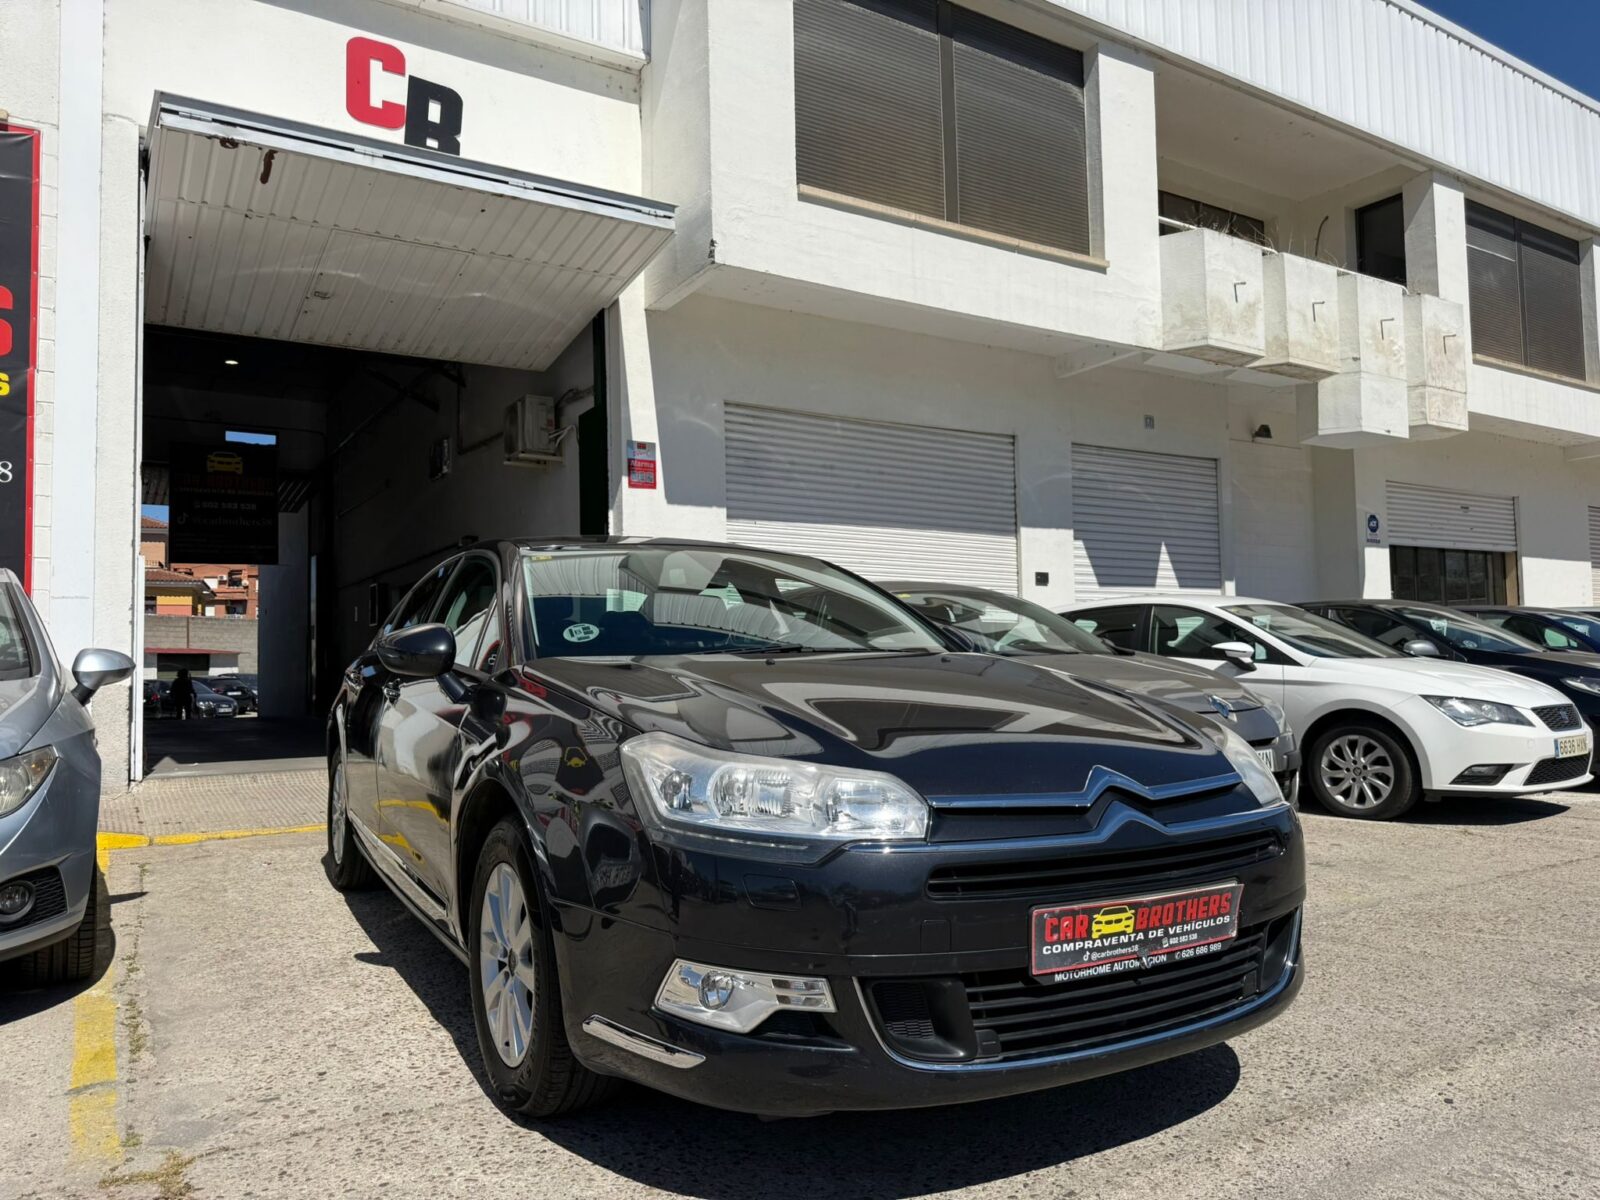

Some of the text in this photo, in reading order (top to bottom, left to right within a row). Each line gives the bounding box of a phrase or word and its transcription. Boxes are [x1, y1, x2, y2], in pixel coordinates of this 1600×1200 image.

[345, 36, 464, 156] CB
[1045, 892, 1232, 943] CAR BROTHERS
[1042, 932, 1144, 955] COMPRAVENTA
[1148, 929, 1164, 939] DE
[1181, 949, 1195, 958] 626
[1209, 942, 1222, 952] 989
[1054, 963, 1111, 982] MOTORHOME
